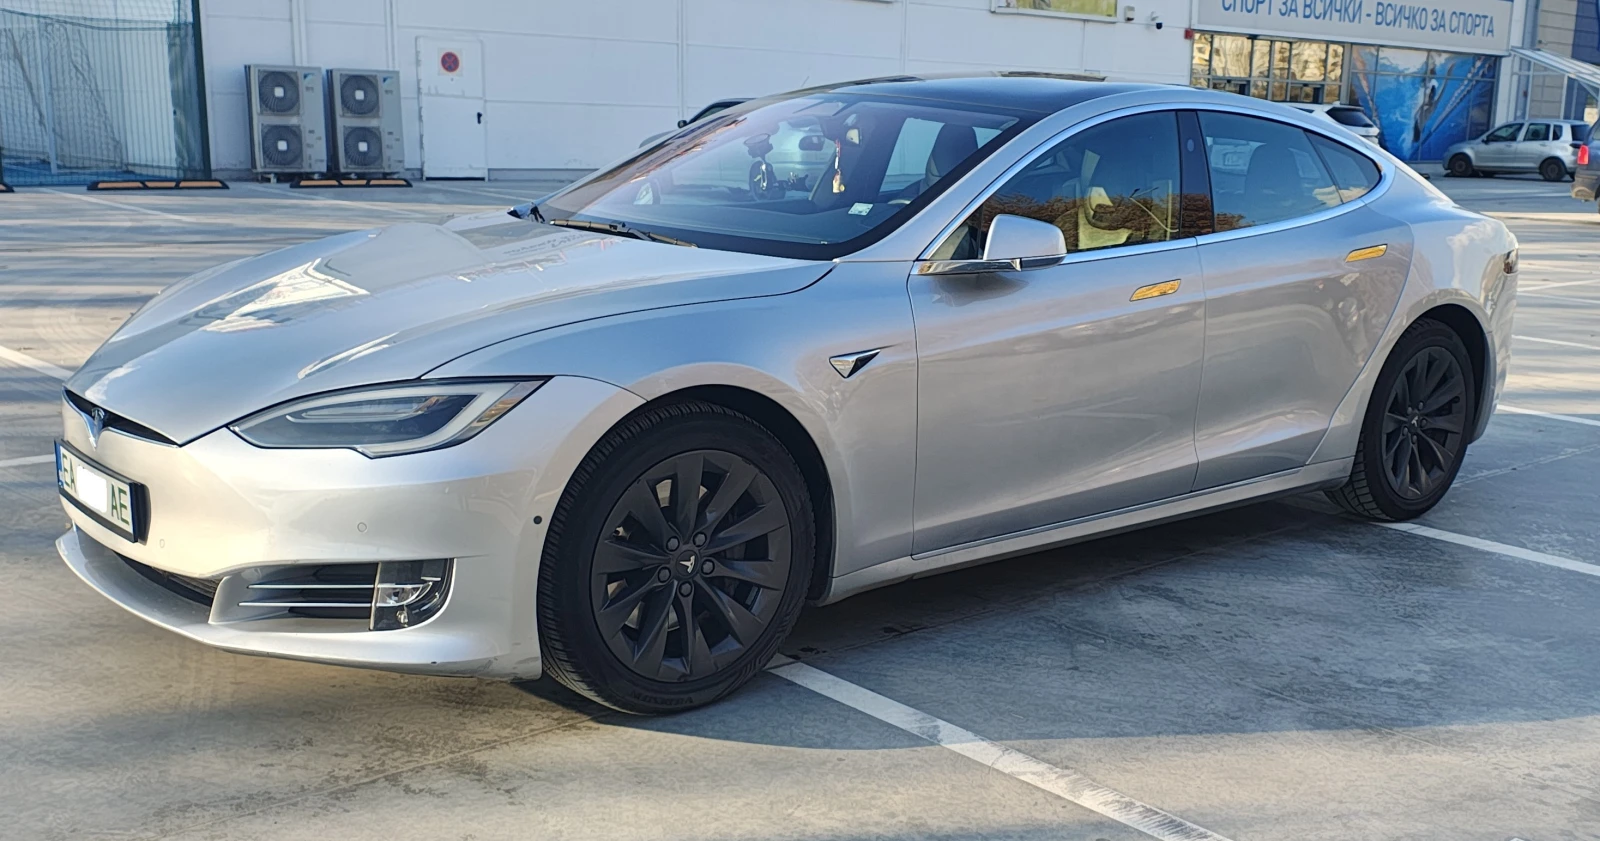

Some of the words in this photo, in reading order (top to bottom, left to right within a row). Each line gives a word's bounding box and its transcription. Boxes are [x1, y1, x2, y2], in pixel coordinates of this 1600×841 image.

[1279, 0, 1298, 17] ЗА
[1302, 0, 1362, 24] ВСИЧКИ
[1375, 2, 1428, 30] ВСИЧКО
[1430, 9, 1446, 33] ЗА
[1449, 11, 1494, 38] СПОРТА
[62, 453, 76, 493] EA
[111, 482, 130, 526] AE
